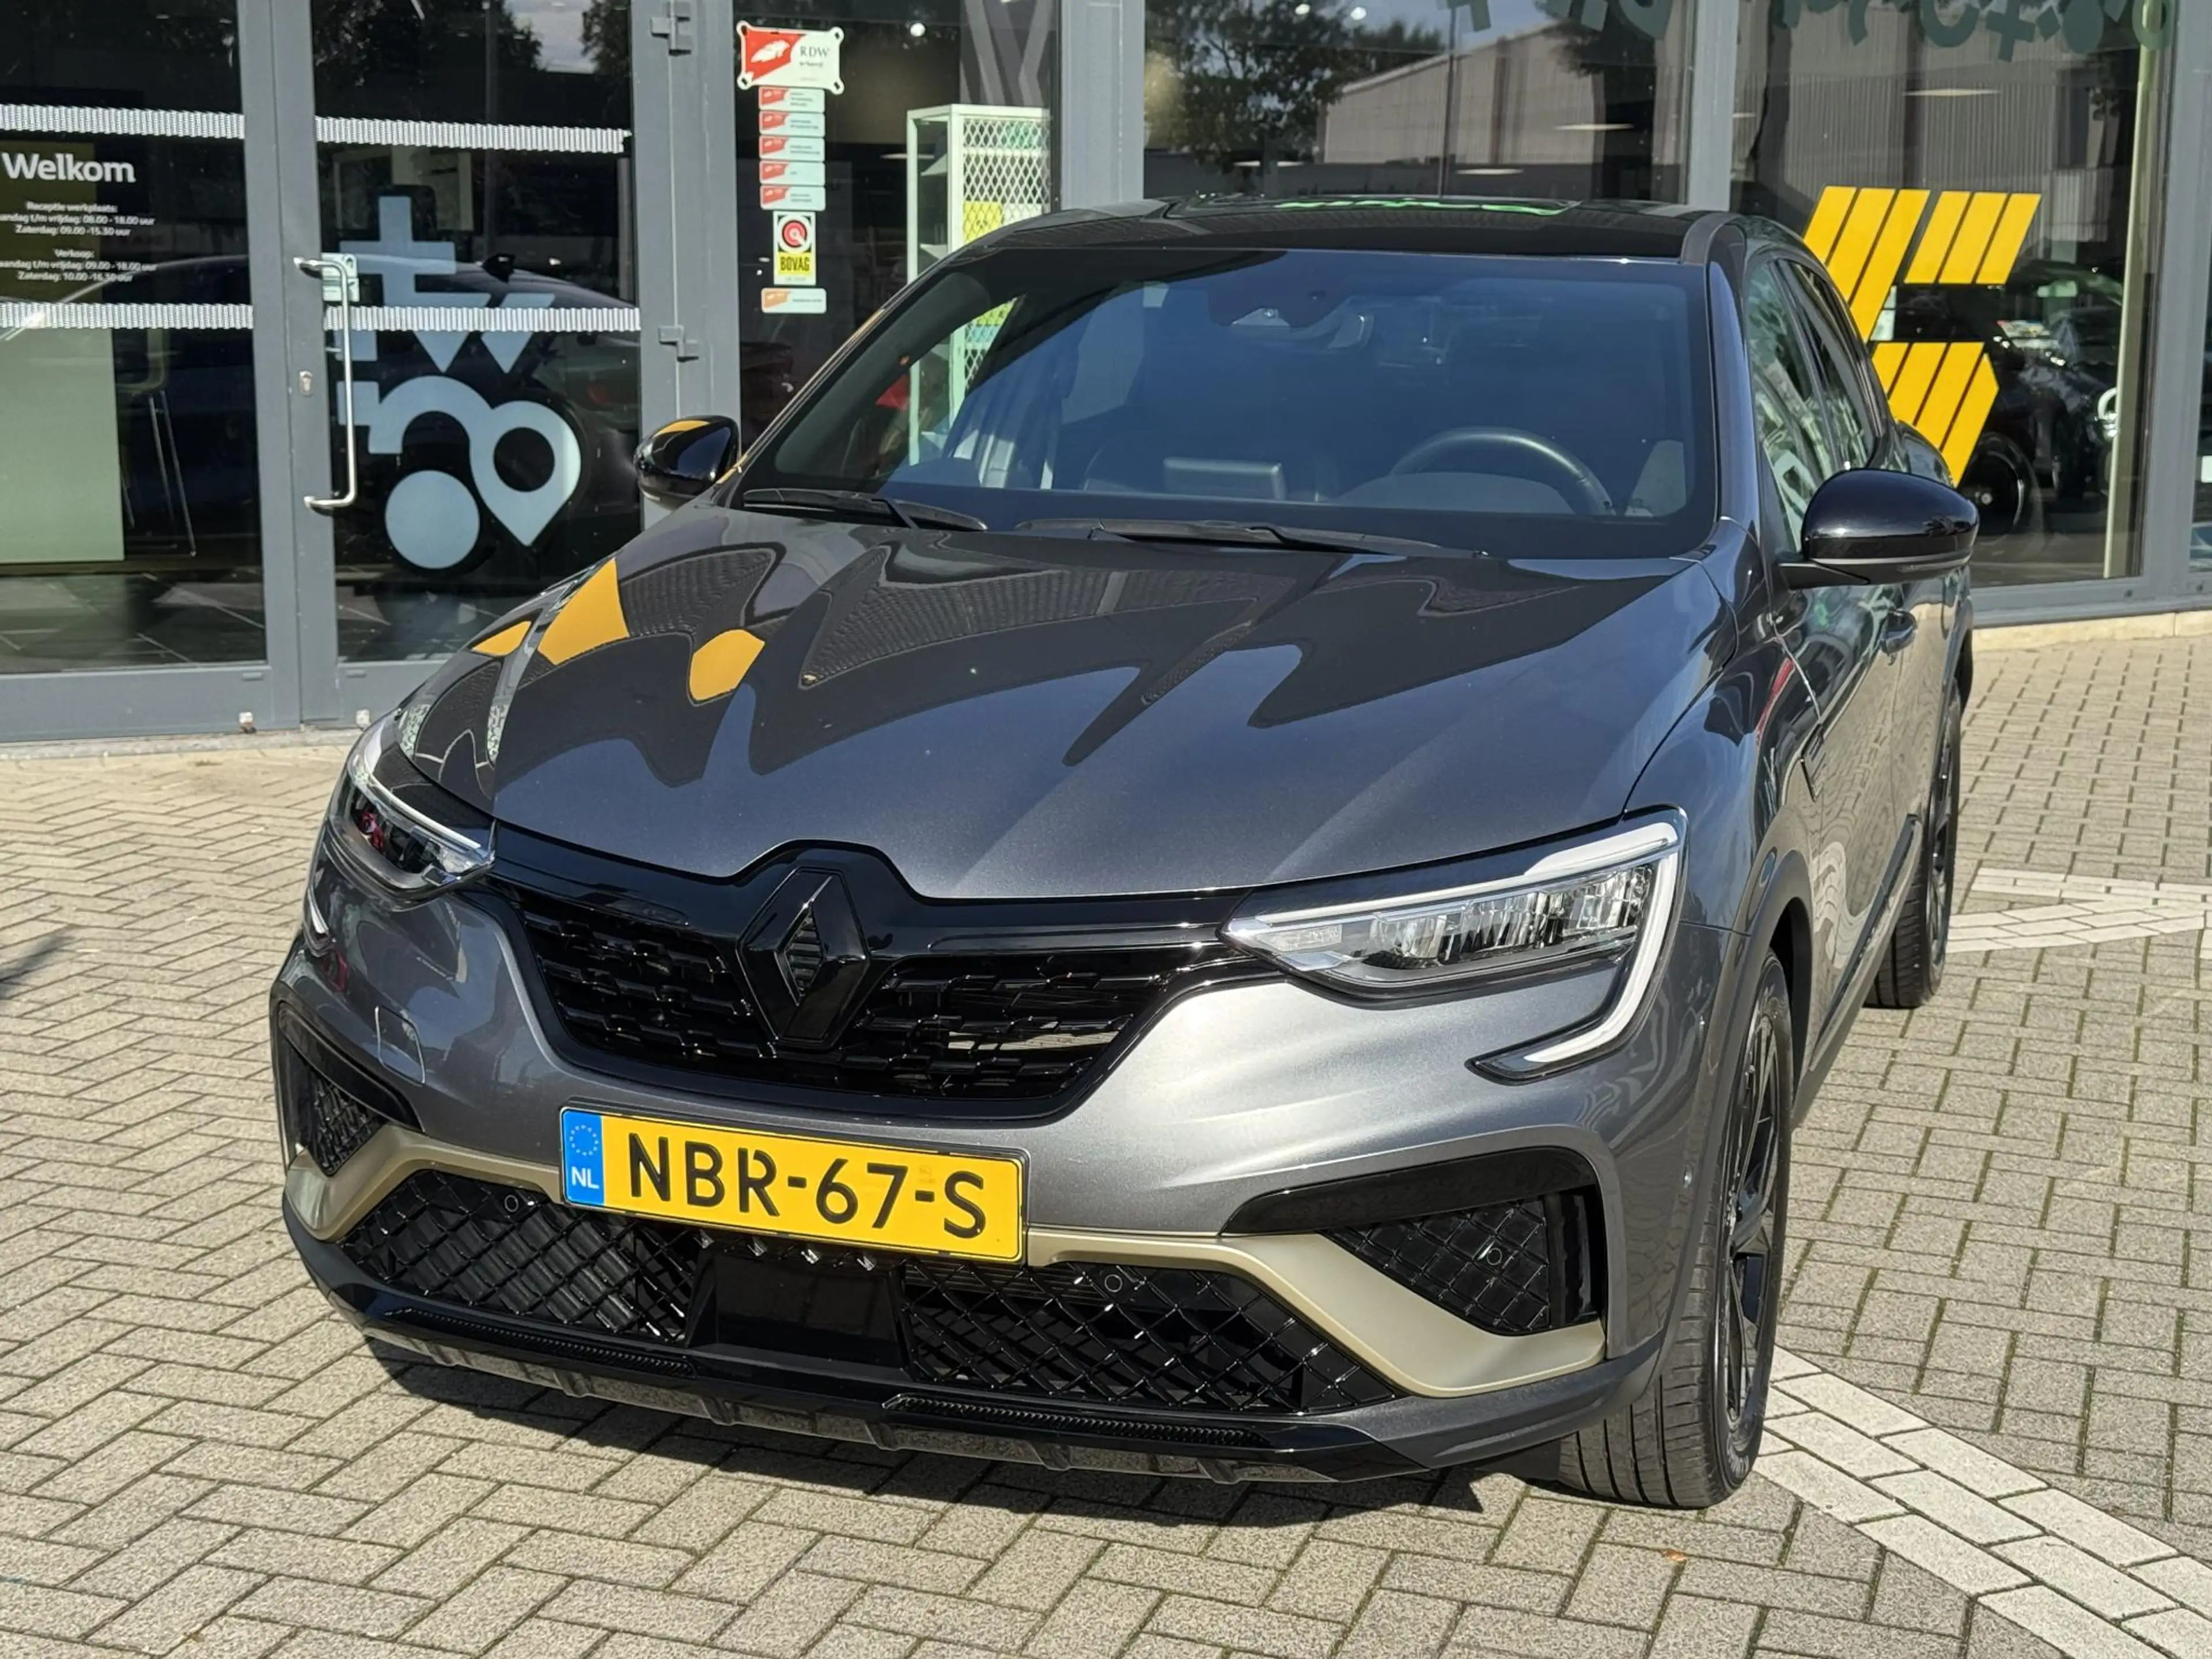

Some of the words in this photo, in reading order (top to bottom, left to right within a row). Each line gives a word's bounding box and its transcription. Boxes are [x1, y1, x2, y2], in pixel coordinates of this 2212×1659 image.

[800, 46, 830, 58] RDW
[1, 152, 136, 183] Welkom
[115, 228, 131, 236] uur
[780, 256, 810, 271] BOVAG
[571, 1165, 600, 1190] NL
[628, 1132, 987, 1238] NBR-67-S
